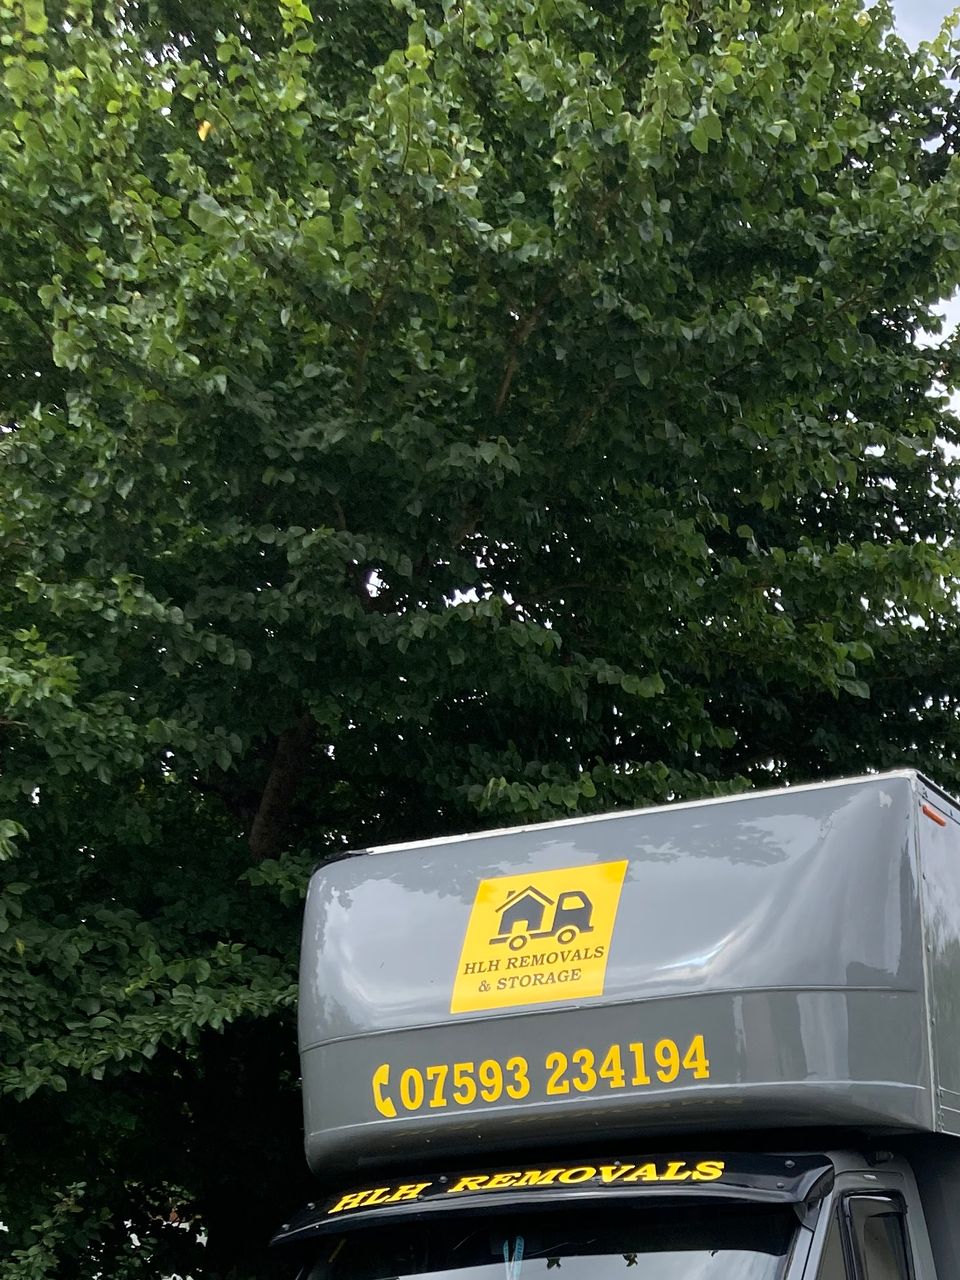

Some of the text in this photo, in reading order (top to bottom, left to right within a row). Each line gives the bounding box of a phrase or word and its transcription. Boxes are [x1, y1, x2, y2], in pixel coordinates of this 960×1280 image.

[463, 945, 605, 976] HLH REMOVALS
[478, 968, 582, 993] & STORAGE
[400, 1035, 710, 1111] 07593 234194
[328, 1160, 725, 1215] HLH REMOVALS
